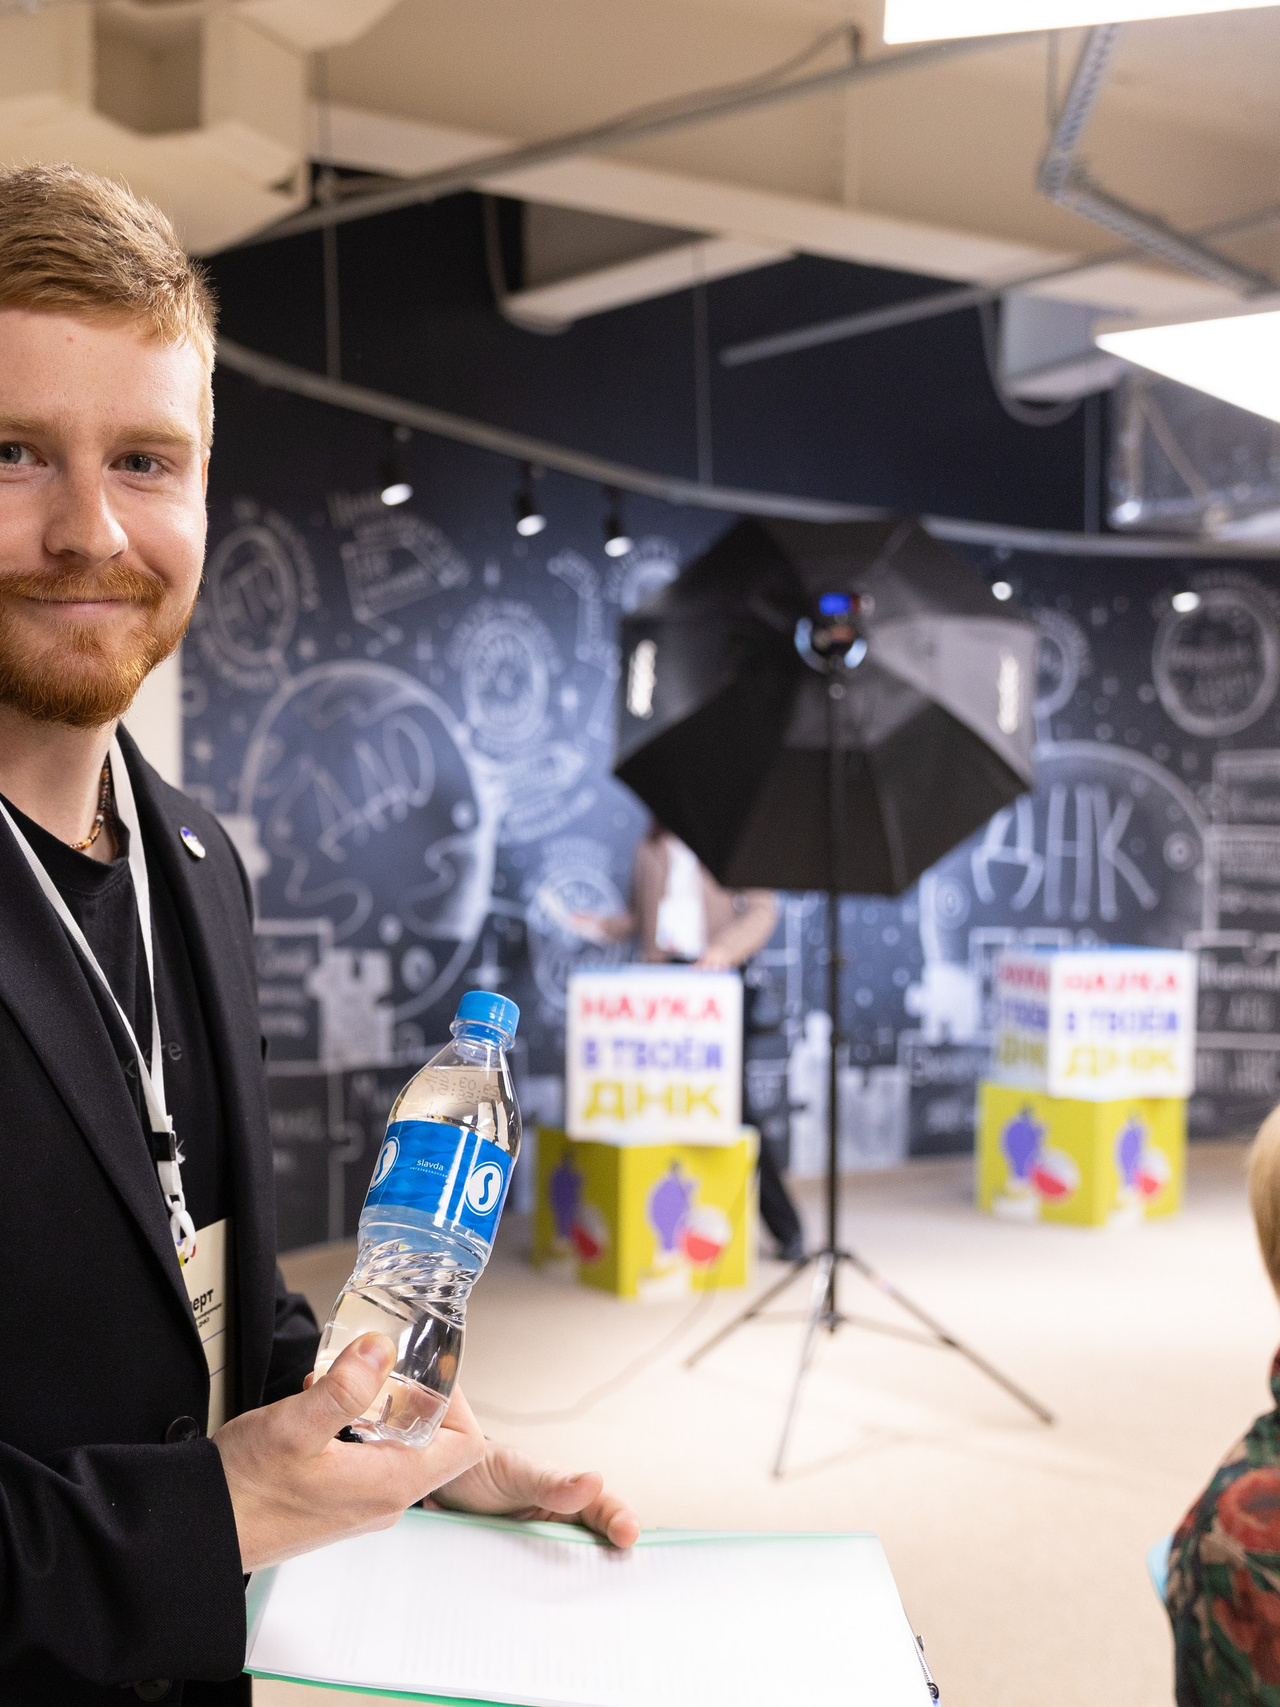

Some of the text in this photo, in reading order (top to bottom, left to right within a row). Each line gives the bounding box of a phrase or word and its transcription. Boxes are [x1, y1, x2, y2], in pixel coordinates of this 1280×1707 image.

[583, 1082, 720, 1121] ДНК
[416, 1158, 444, 1171] slavda
[190, 1289, 214, 1313] ерт
